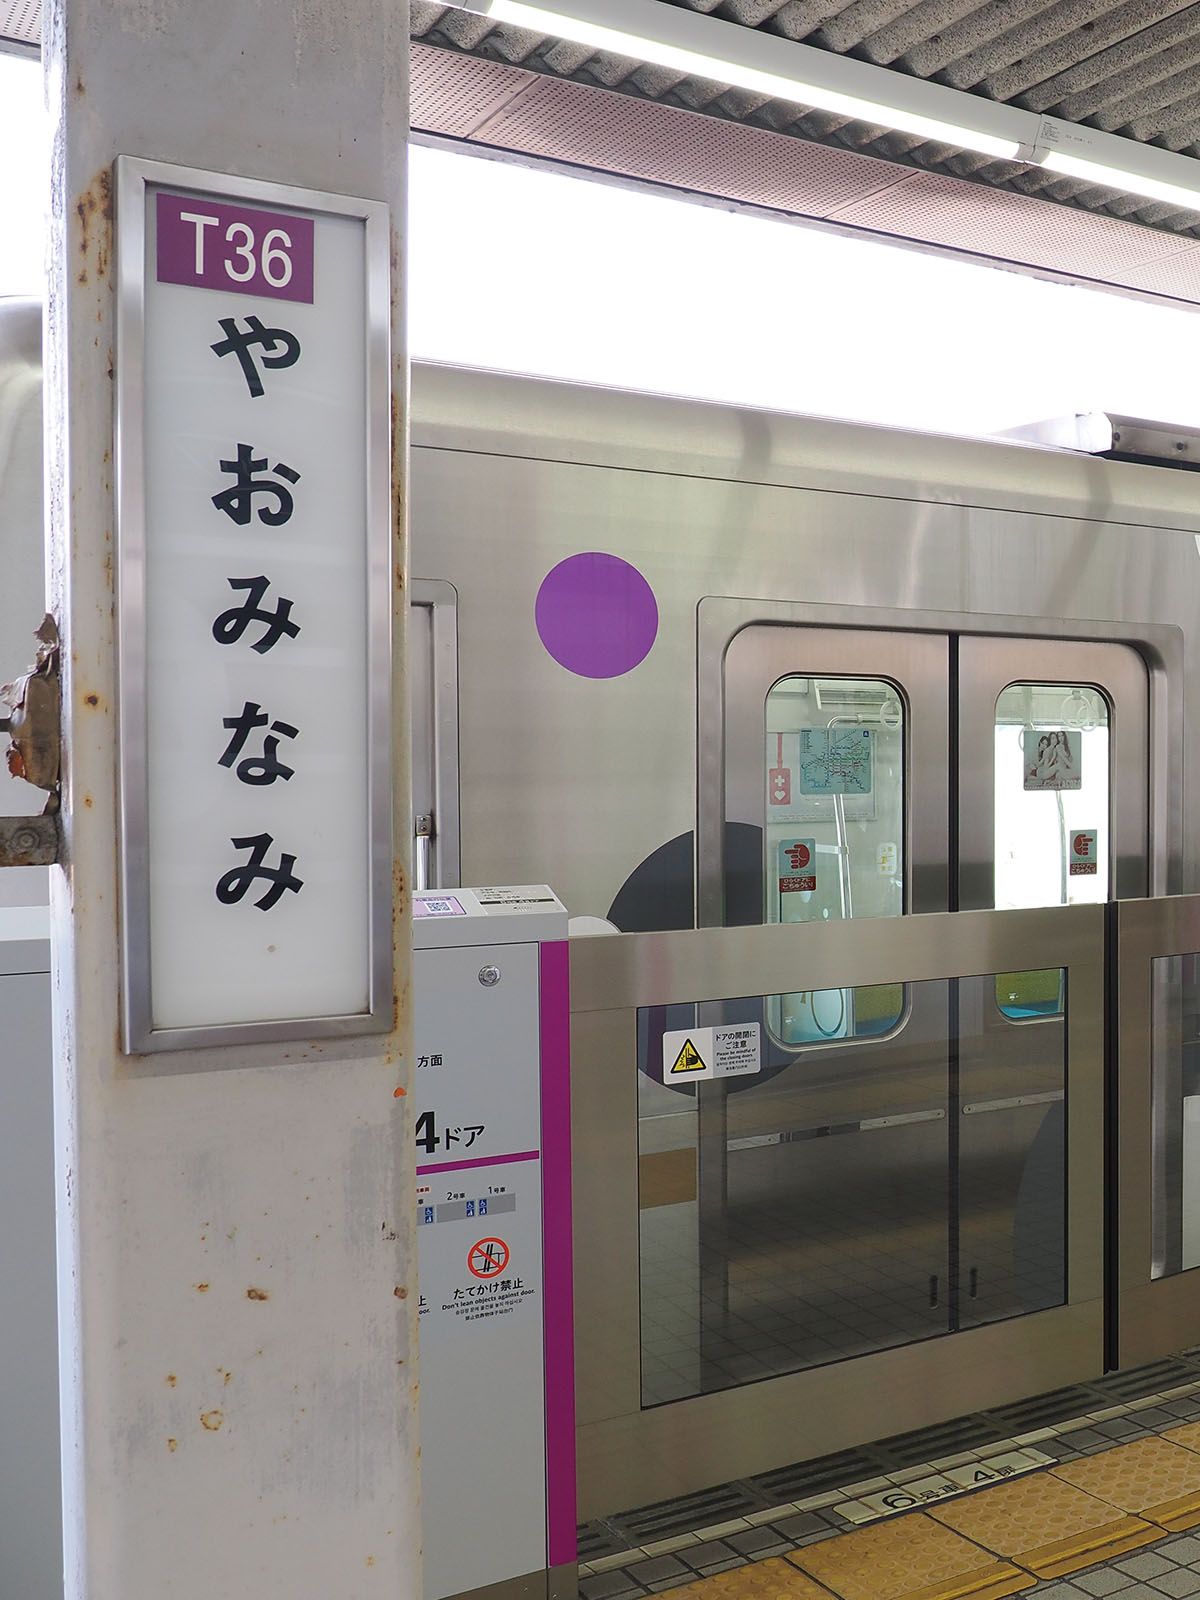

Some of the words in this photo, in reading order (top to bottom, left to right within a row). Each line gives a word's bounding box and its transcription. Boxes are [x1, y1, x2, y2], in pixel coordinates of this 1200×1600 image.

[180, 211, 293, 288] T36
[211, 314, 304, 912] やおみなみ
[725, 1040, 747, 1049] ご注意
[417, 1054, 443, 1068] 方面
[453, 1278, 524, 1300] たてかけ禁止
[441, 1302, 459, 1311] Don't
[460, 1300, 473, 1308] lean
[474, 1296, 497, 1306] objects
[498, 1292, 519, 1301] against
